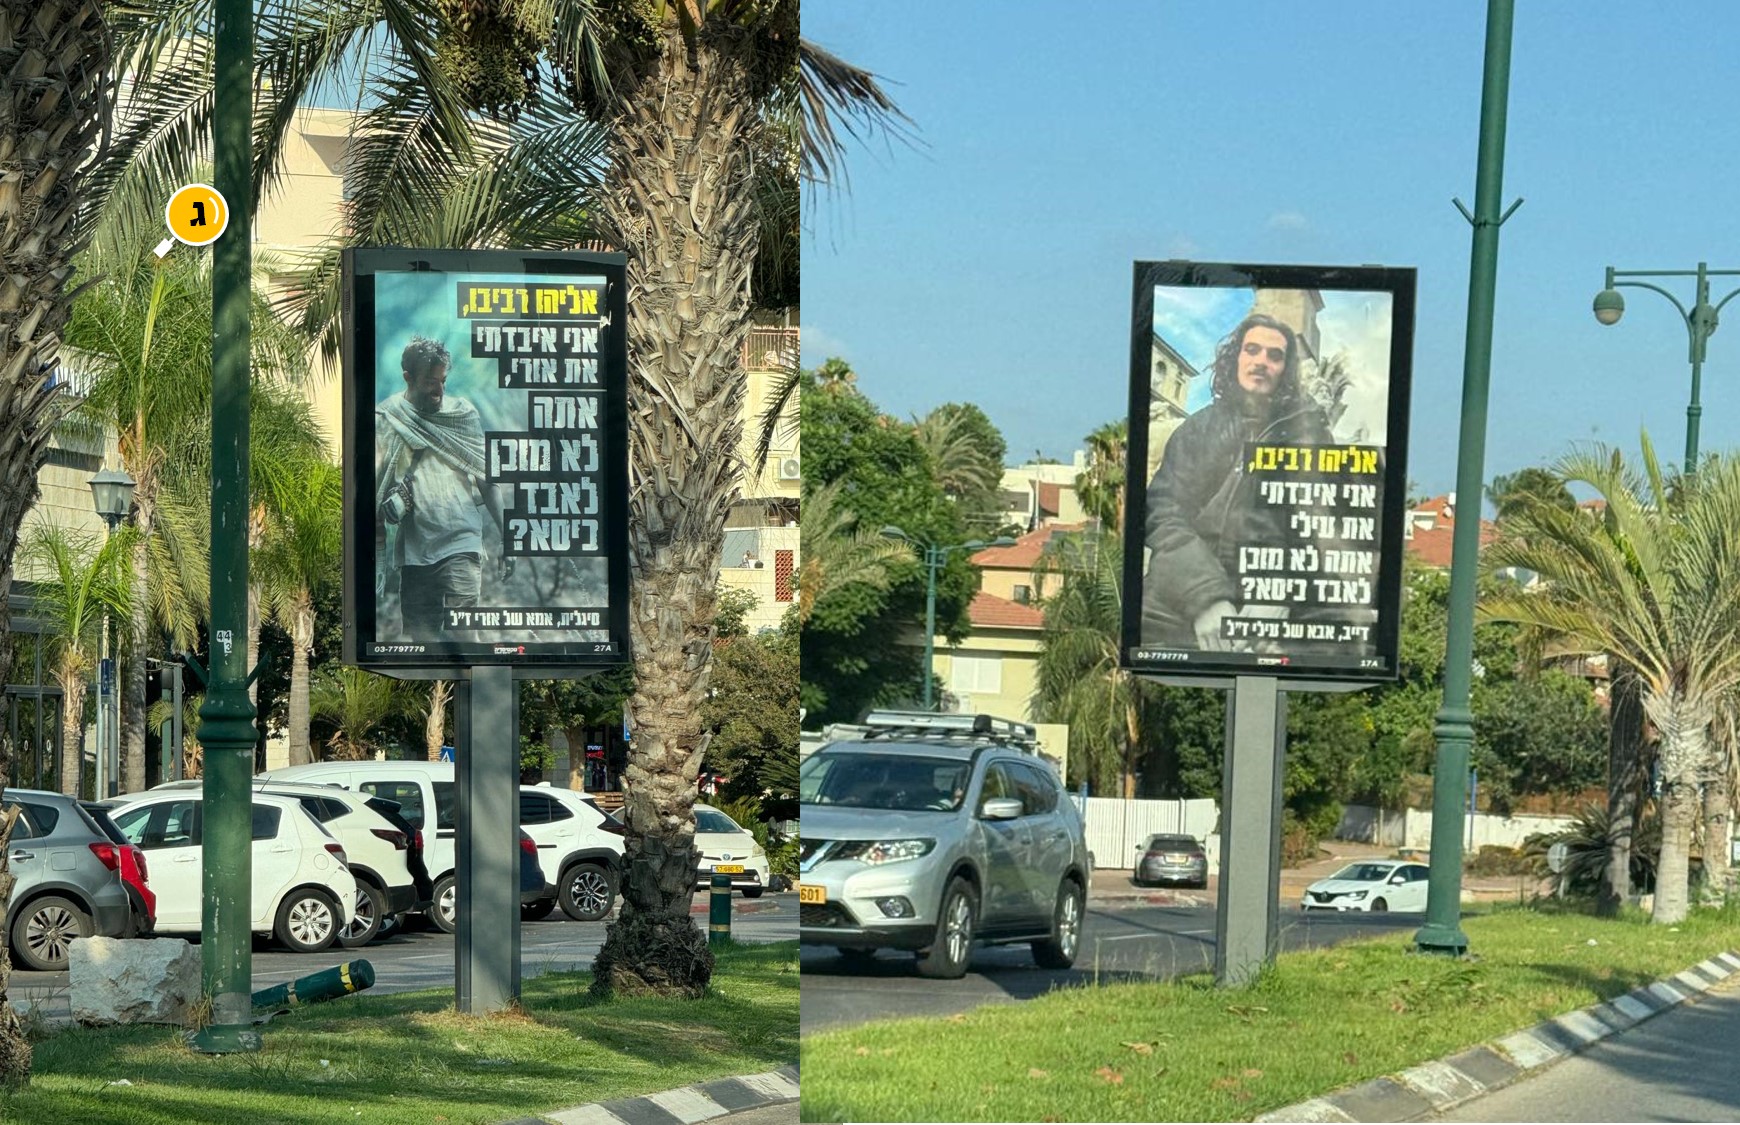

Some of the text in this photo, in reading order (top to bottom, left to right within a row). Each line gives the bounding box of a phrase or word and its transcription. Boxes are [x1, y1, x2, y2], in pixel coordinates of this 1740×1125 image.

[463, 285, 598, 317] אליהו רביבו,
[477, 327, 598, 353] אני איבדתי
[504, 358, 598, 387] את אורי,
[533, 397, 598, 429] אתה
[491, 434, 599, 477] לא מוכן
[1249, 446, 1377, 473] אליהו רביבו,
[520, 477, 599, 514] לאבד
[1261, 481, 1376, 508] אני איבדתי
[509, 519, 599, 551] כיסא?
[1291, 511, 1374, 540] את עילי
[1239, 545, 1372, 574] אתה לא מוכן
[1241, 577, 1371, 604] לאבד כיסא?
[475, 612, 500, 626] אורי
[503, 610, 523, 626] של
[526, 612, 553, 626] אמא
[557, 610, 600, 628] סיגלית,
[1252, 620, 1280, 637] עילי
[1282, 622, 1304, 639] של
[218, 632, 230, 640] 44
[1307, 624, 1335, 640] אבא
[226, 643, 231, 651] 3
